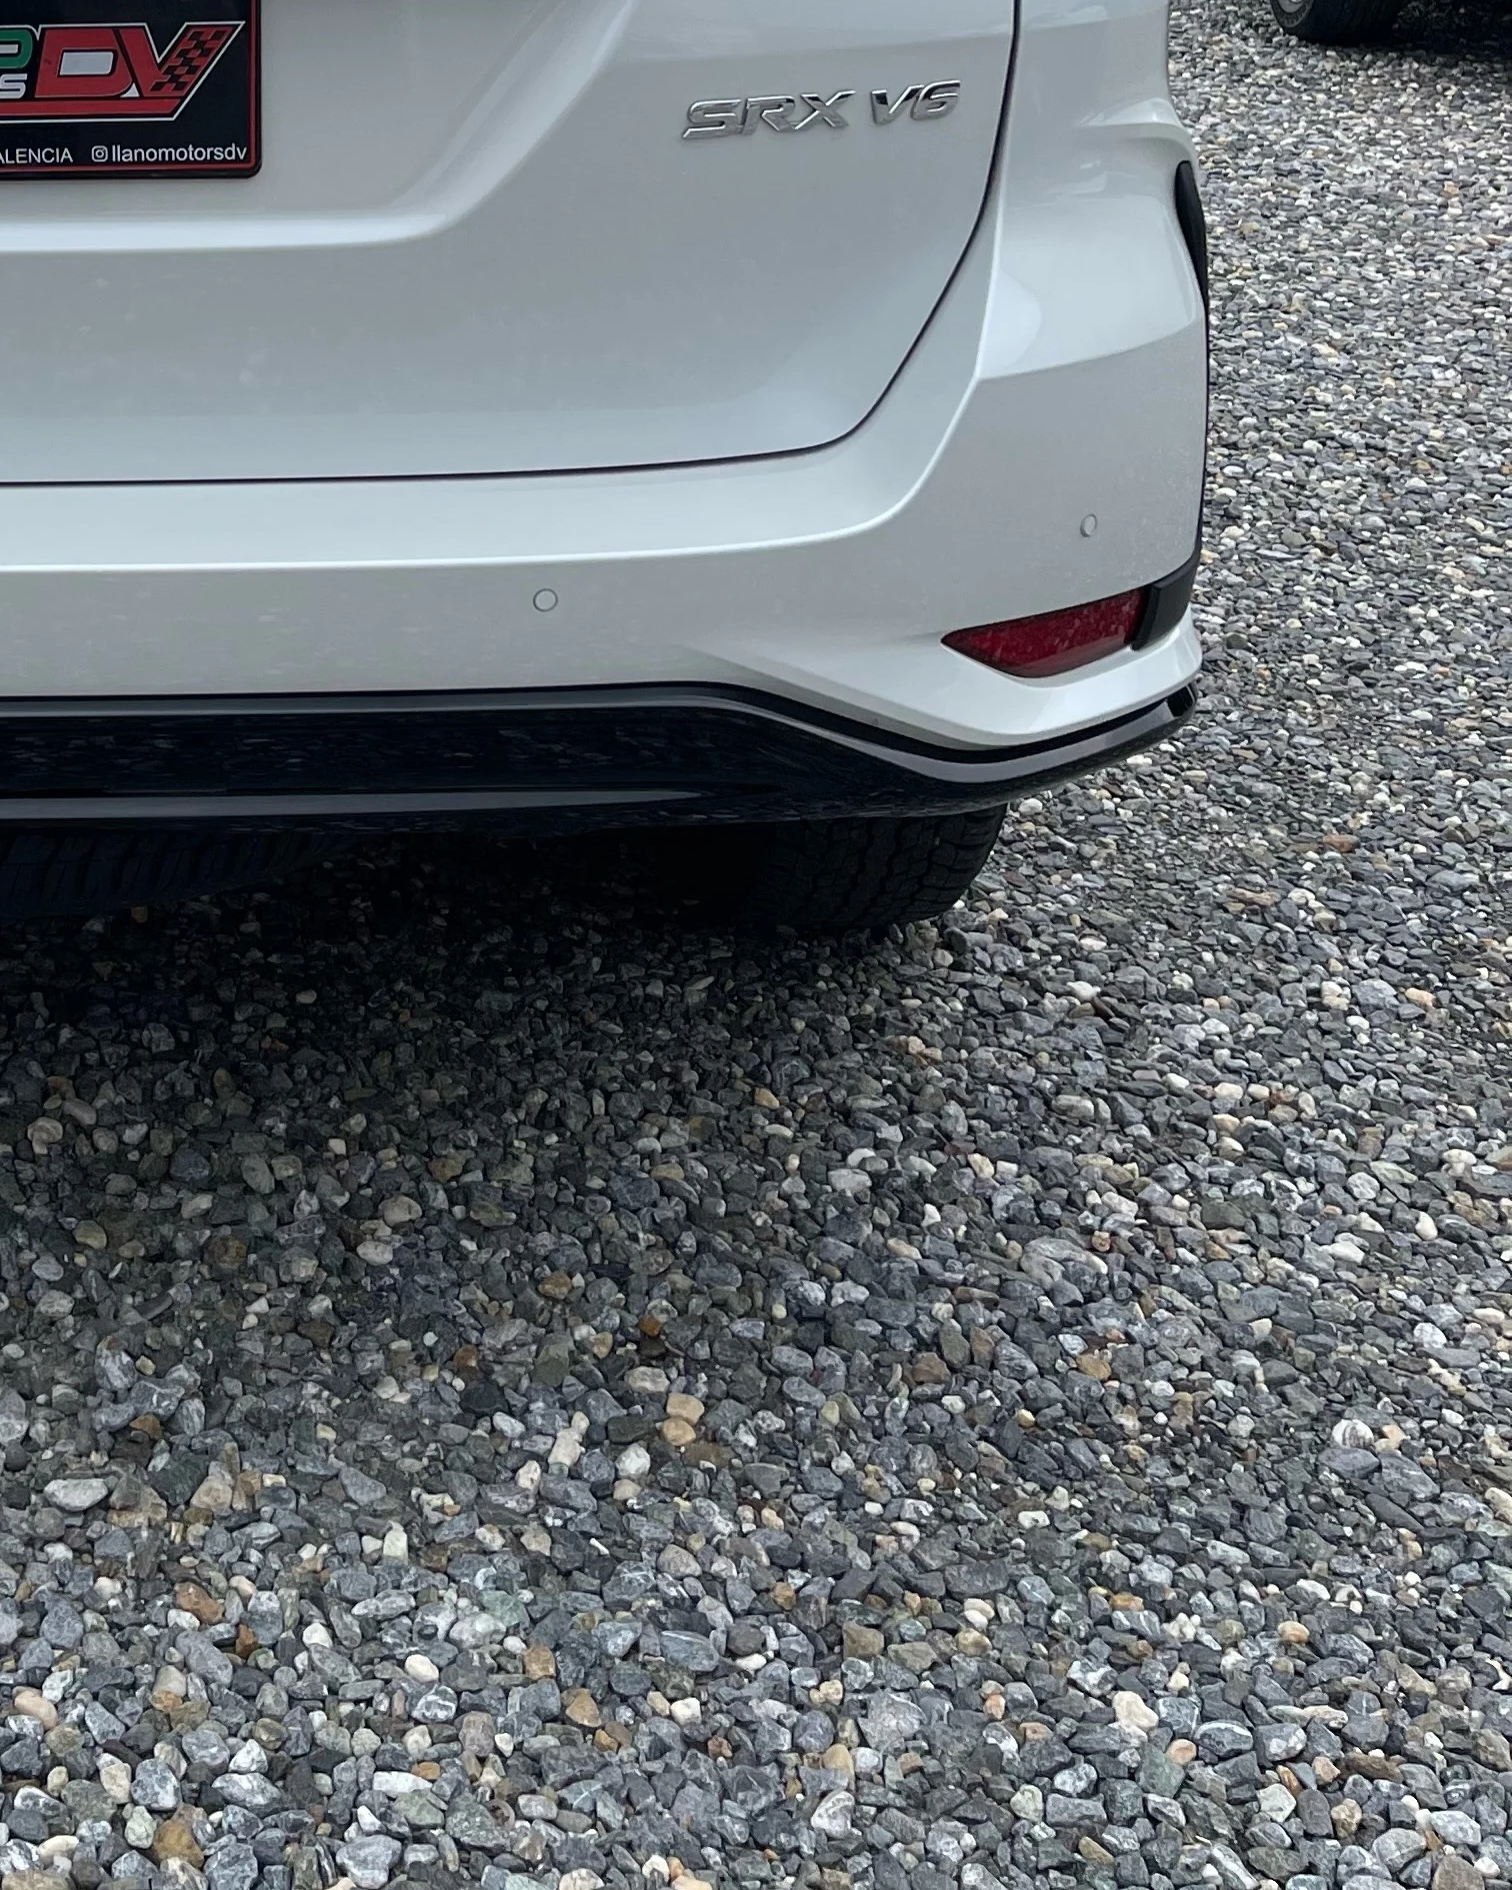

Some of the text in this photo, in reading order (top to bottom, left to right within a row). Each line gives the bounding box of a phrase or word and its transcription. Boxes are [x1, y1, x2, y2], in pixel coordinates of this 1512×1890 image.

[34, 26, 234, 99] DV
[681, 78, 962, 140] SRX V6
